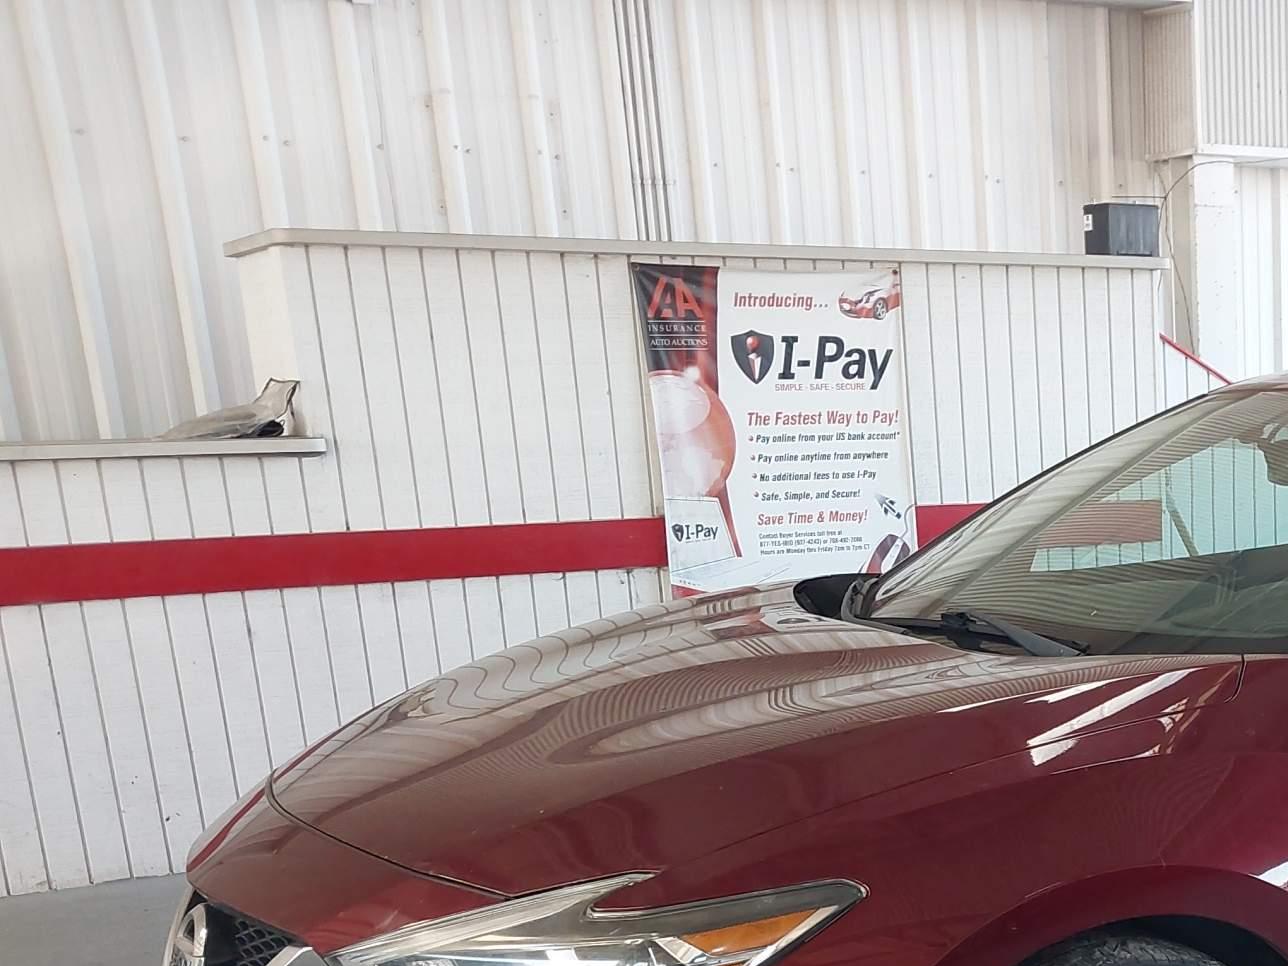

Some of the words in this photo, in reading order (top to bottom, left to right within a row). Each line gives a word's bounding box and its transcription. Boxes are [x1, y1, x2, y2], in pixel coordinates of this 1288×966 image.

[734, 292, 828, 310] Introducing...
[648, 324, 706, 332] INSURANCE
[672, 338, 708, 346] AUCTIONS
[778, 335, 894, 390] I-Pay
[810, 383, 830, 391] SAFE
[836, 382, 865, 390] SECURE
[748, 412, 770, 426] The
[774, 410, 822, 426] Fastest
[827, 410, 851, 427] Way
[856, 411, 868, 424] to
[872, 410, 899, 426] Pay!
[756, 434, 770, 445] Pay
[772, 434, 796, 442] online
[798, 433, 815, 442] from
[817, 434, 834, 443] your
[836, 432, 846, 440] US
[848, 432, 866, 440] bank
[758, 454, 772, 464] Pay
[774, 453, 798, 462] online
[800, 452, 831, 463] anytime
[834, 452, 851, 460] from
[852, 450, 888, 461] anywhere
[760, 474, 770, 482] No
[772, 472, 811, 482] additional
[814, 472, 830, 480] fees
[832, 471, 840, 480] to
[857, 470, 876, 480] I-Pay
[761, 492, 782, 502] Safe,
[784, 490, 812, 502] Simple,
[816, 490, 830, 499] and
[832, 489, 860, 498] Secure!
[758, 514, 784, 526] Save
[788, 512, 813, 524] Time
[816, 510, 824, 522] &
[828, 510, 868, 524] Money!
[684, 524, 718, 540] I-Pay
